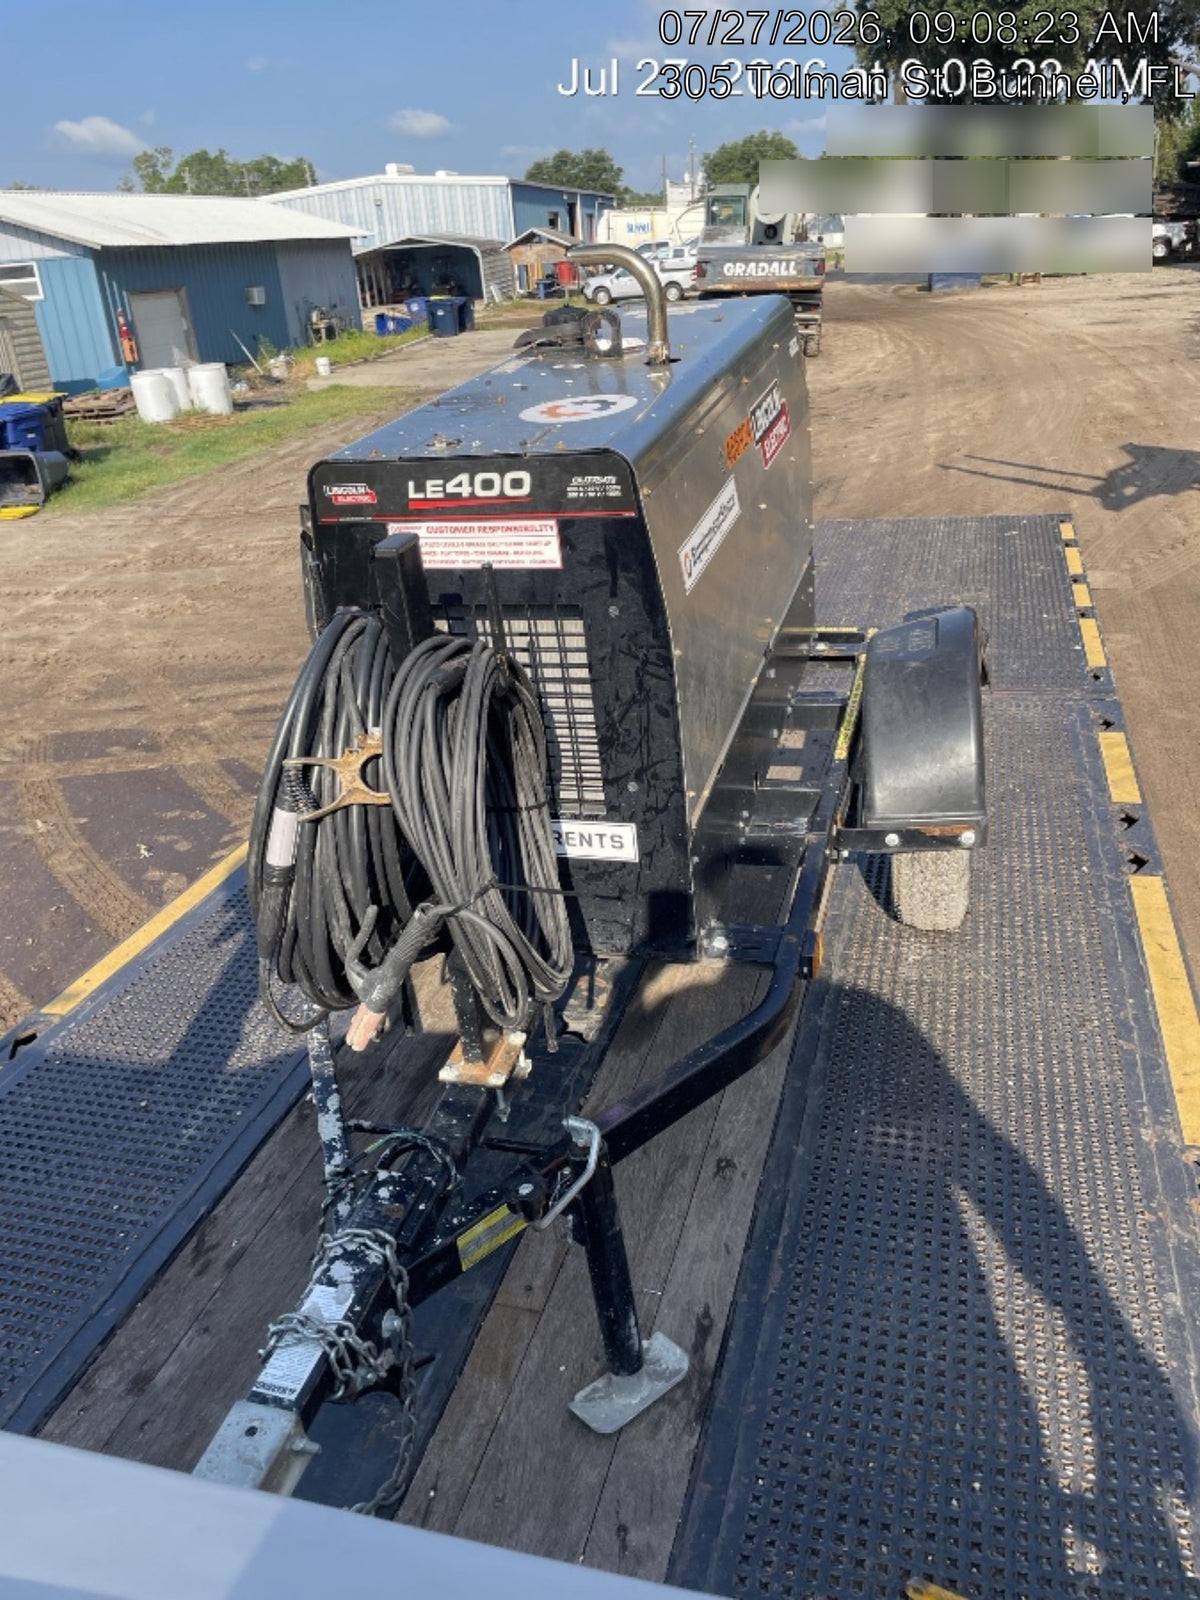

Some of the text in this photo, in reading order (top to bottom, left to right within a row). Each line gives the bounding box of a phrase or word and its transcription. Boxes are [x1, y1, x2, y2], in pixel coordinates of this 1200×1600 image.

[723, 261, 797, 277] GRADALL
[408, 470, 531, 499] LE400
[426, 525, 475, 535] CUSTOMER
[553, 831, 624, 849] RENTS
